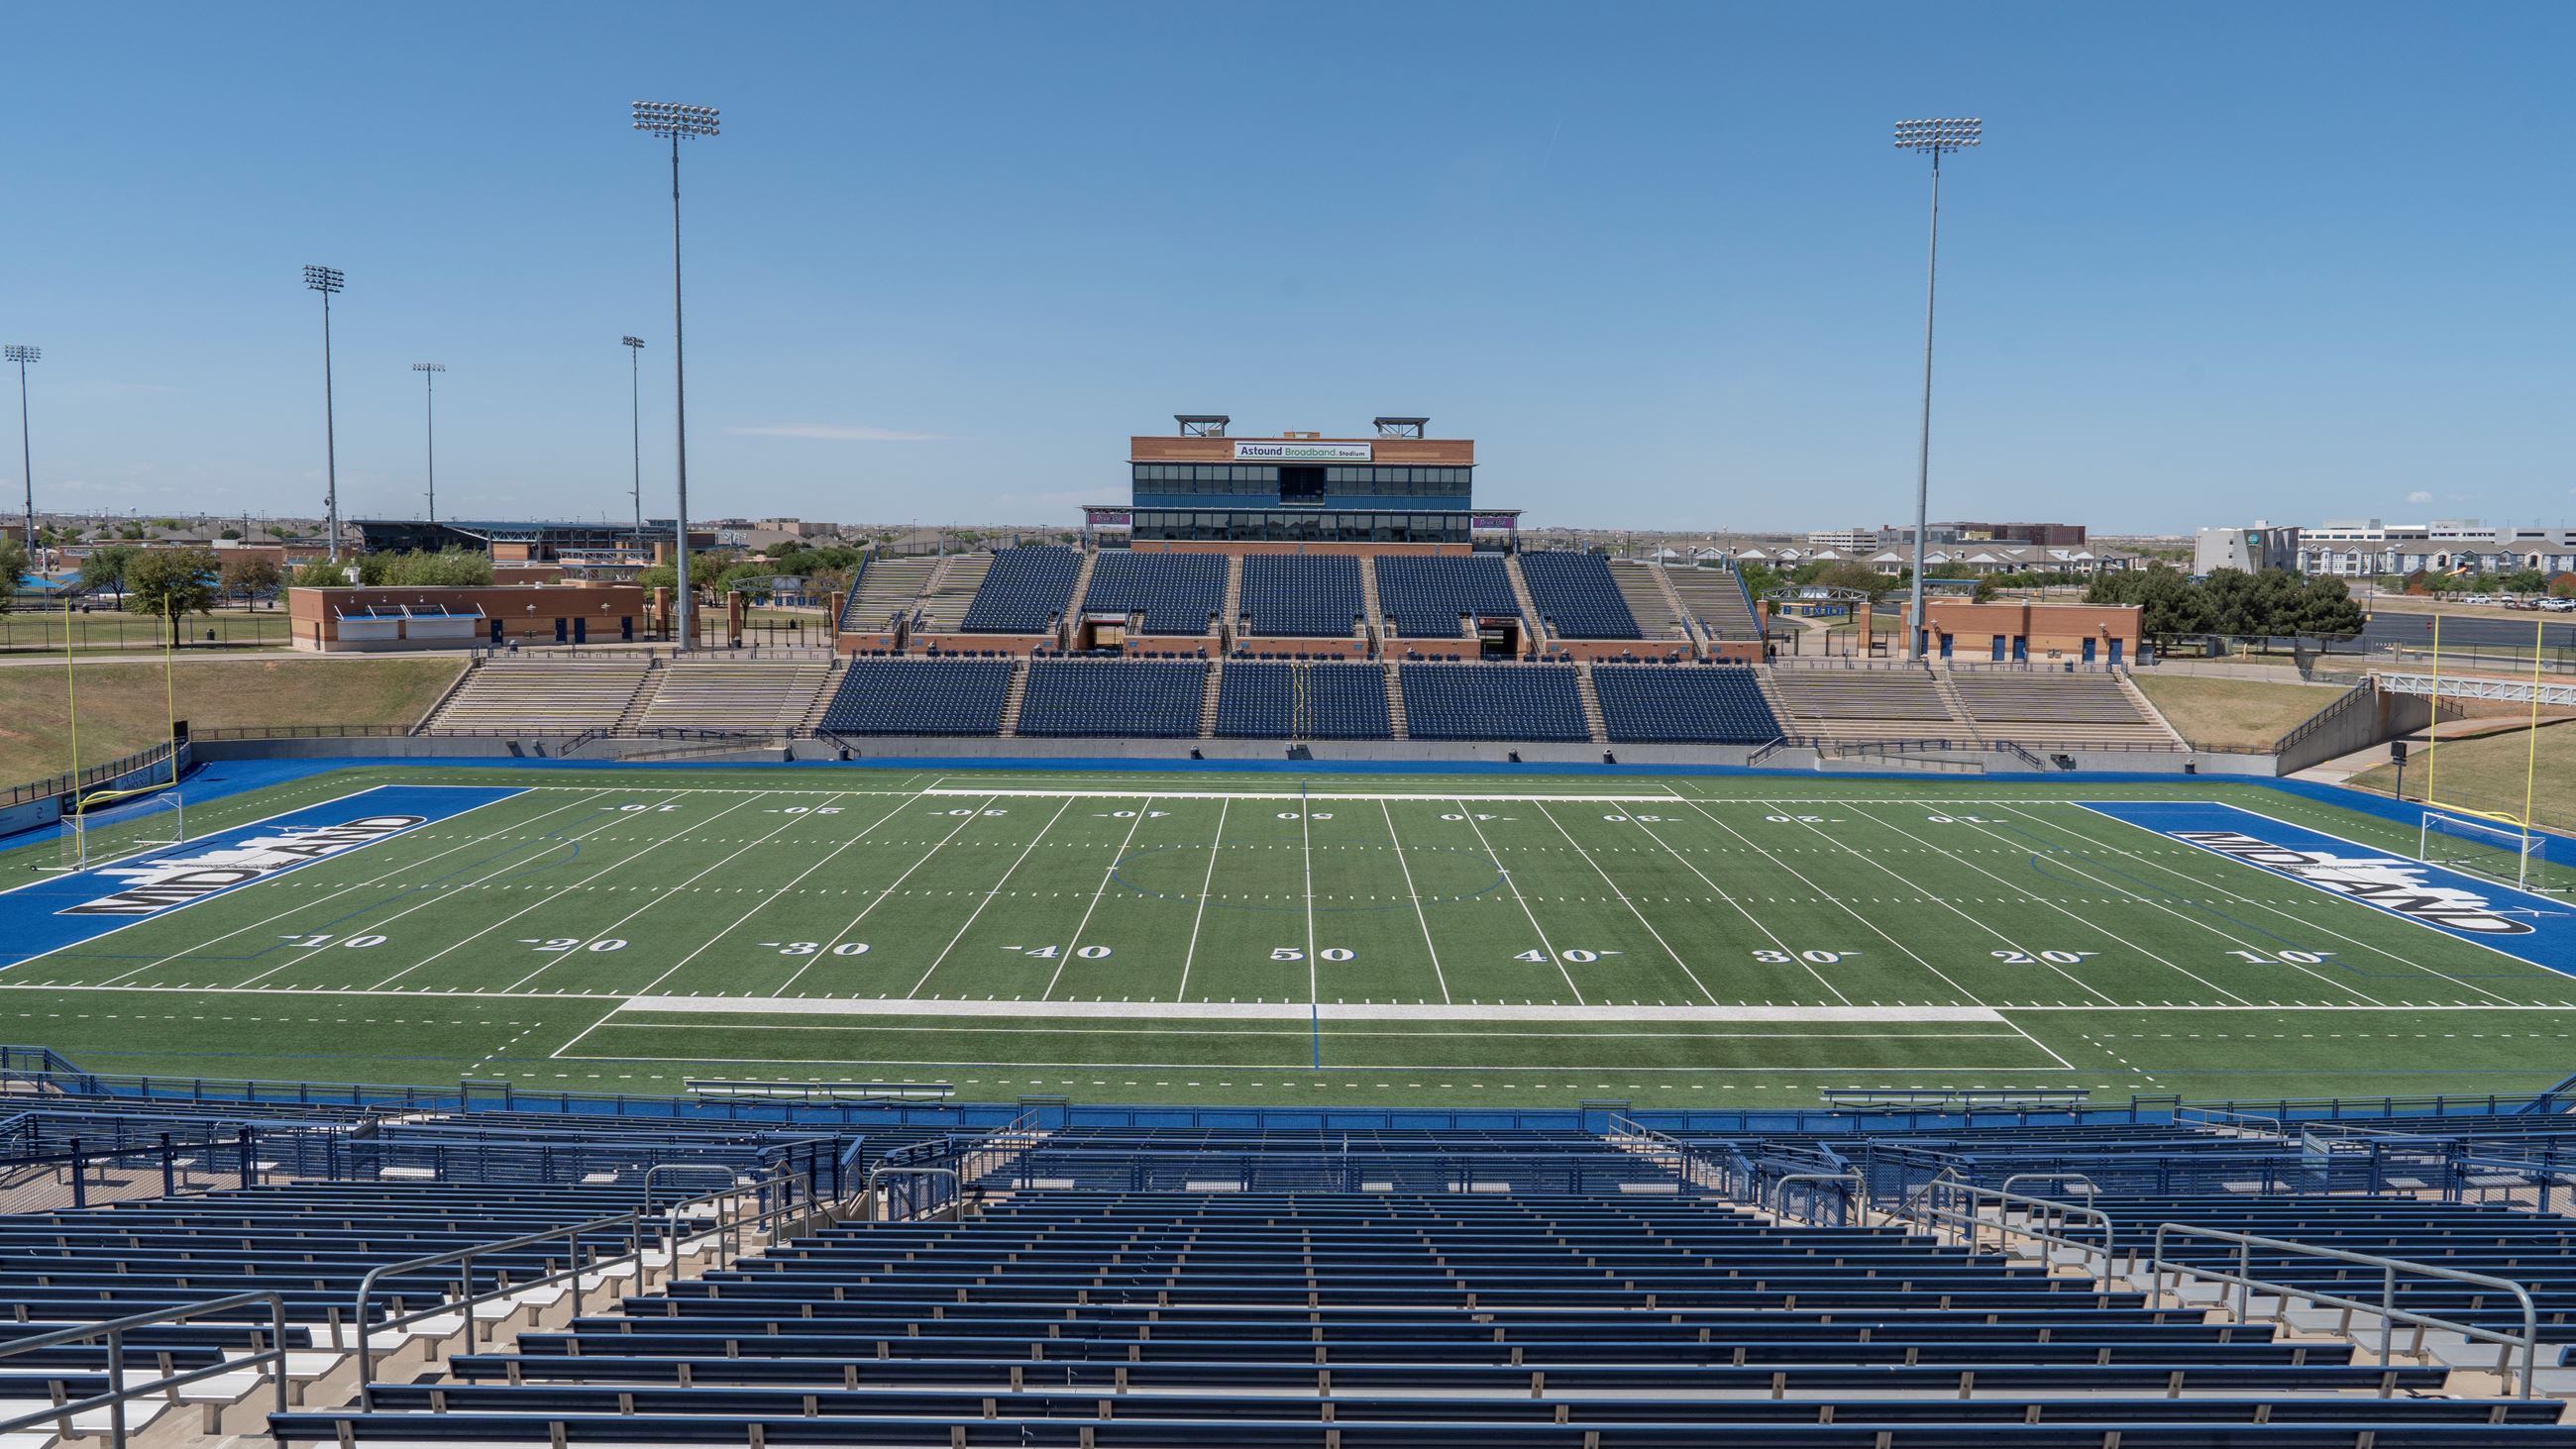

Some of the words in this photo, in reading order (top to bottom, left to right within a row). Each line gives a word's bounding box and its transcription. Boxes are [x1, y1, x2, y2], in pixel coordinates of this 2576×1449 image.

[1240, 446, 1282, 456] Astound
[1802, 606, 1843, 615] EXIT
[288, 934, 387, 948] 10
[531, 938, 628, 952] 20
[779, 942, 870, 955] 30
[1024, 945, 1112, 959] 40
[1269, 948, 1355, 961] 50
[1513, 949, 1597, 963] 40
[1752, 950, 1840, 964] 30
[1990, 950, 2082, 964] 20
[2225, 950, 2323, 964] 10
